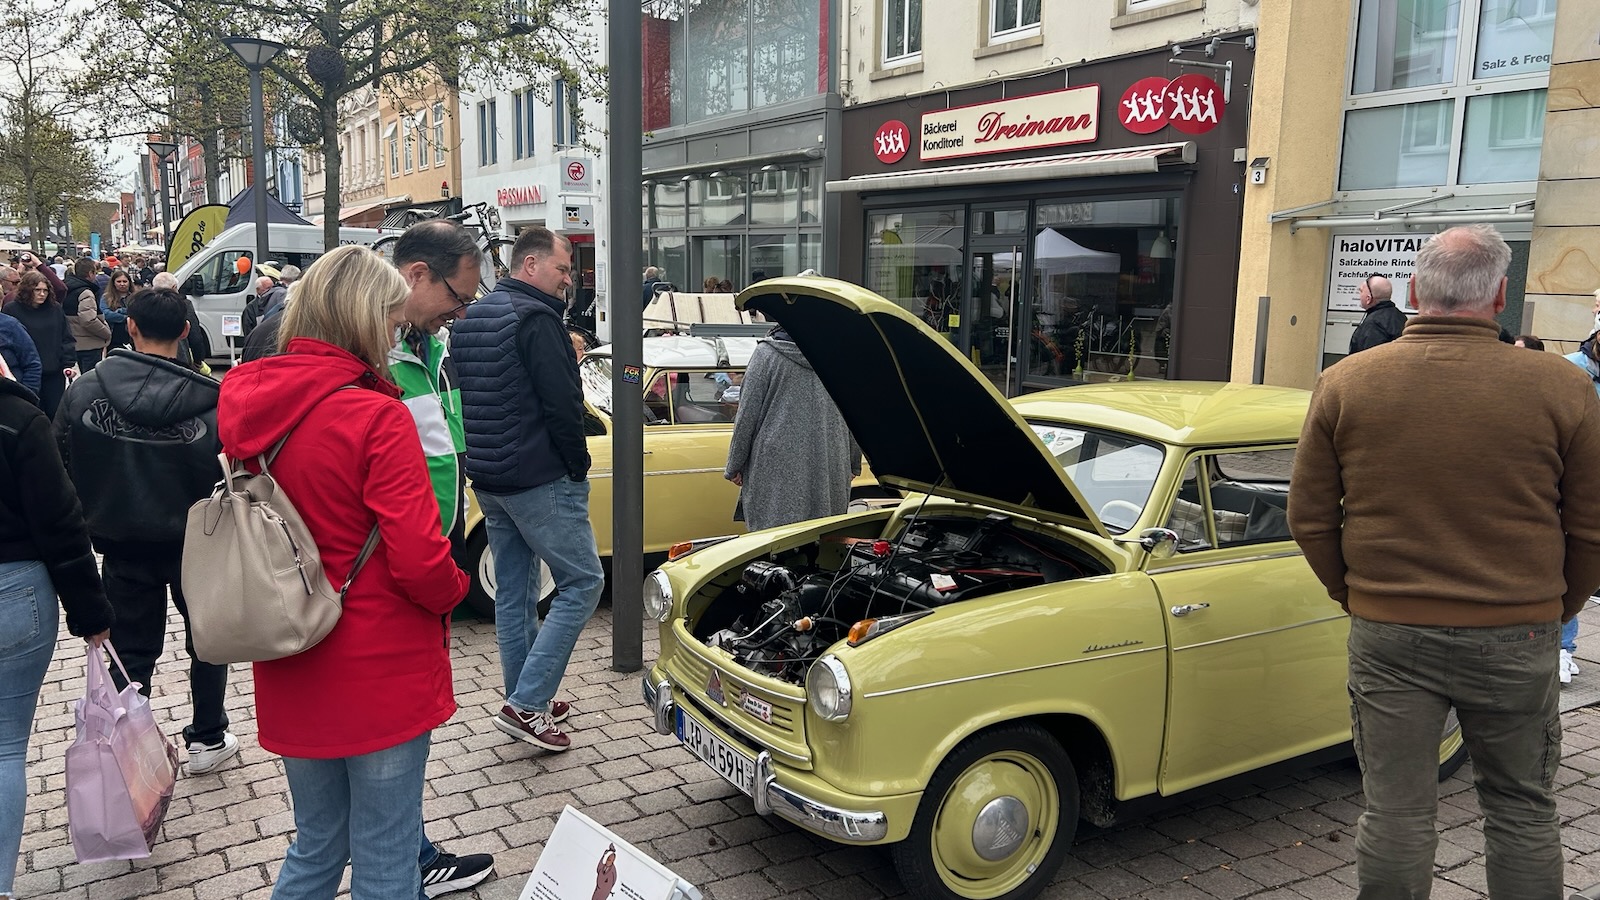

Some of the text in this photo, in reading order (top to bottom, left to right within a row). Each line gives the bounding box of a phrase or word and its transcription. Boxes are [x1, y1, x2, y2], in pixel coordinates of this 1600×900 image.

[1482, 59, 1507, 71] Salz
[1510, 56, 1520, 66] &
[923, 120, 958, 135] Bäckerei
[974, 111, 1092, 144] Dreimann
[922, 136, 964, 151] Konditorei
[1255, 171, 1261, 182] 3
[497, 185, 542, 207] ROSSMANN
[1339, 258, 1389, 267] Salzkabine
[624, 368, 640, 376] FCK
[684, 715, 744, 787] LIP A 59H
